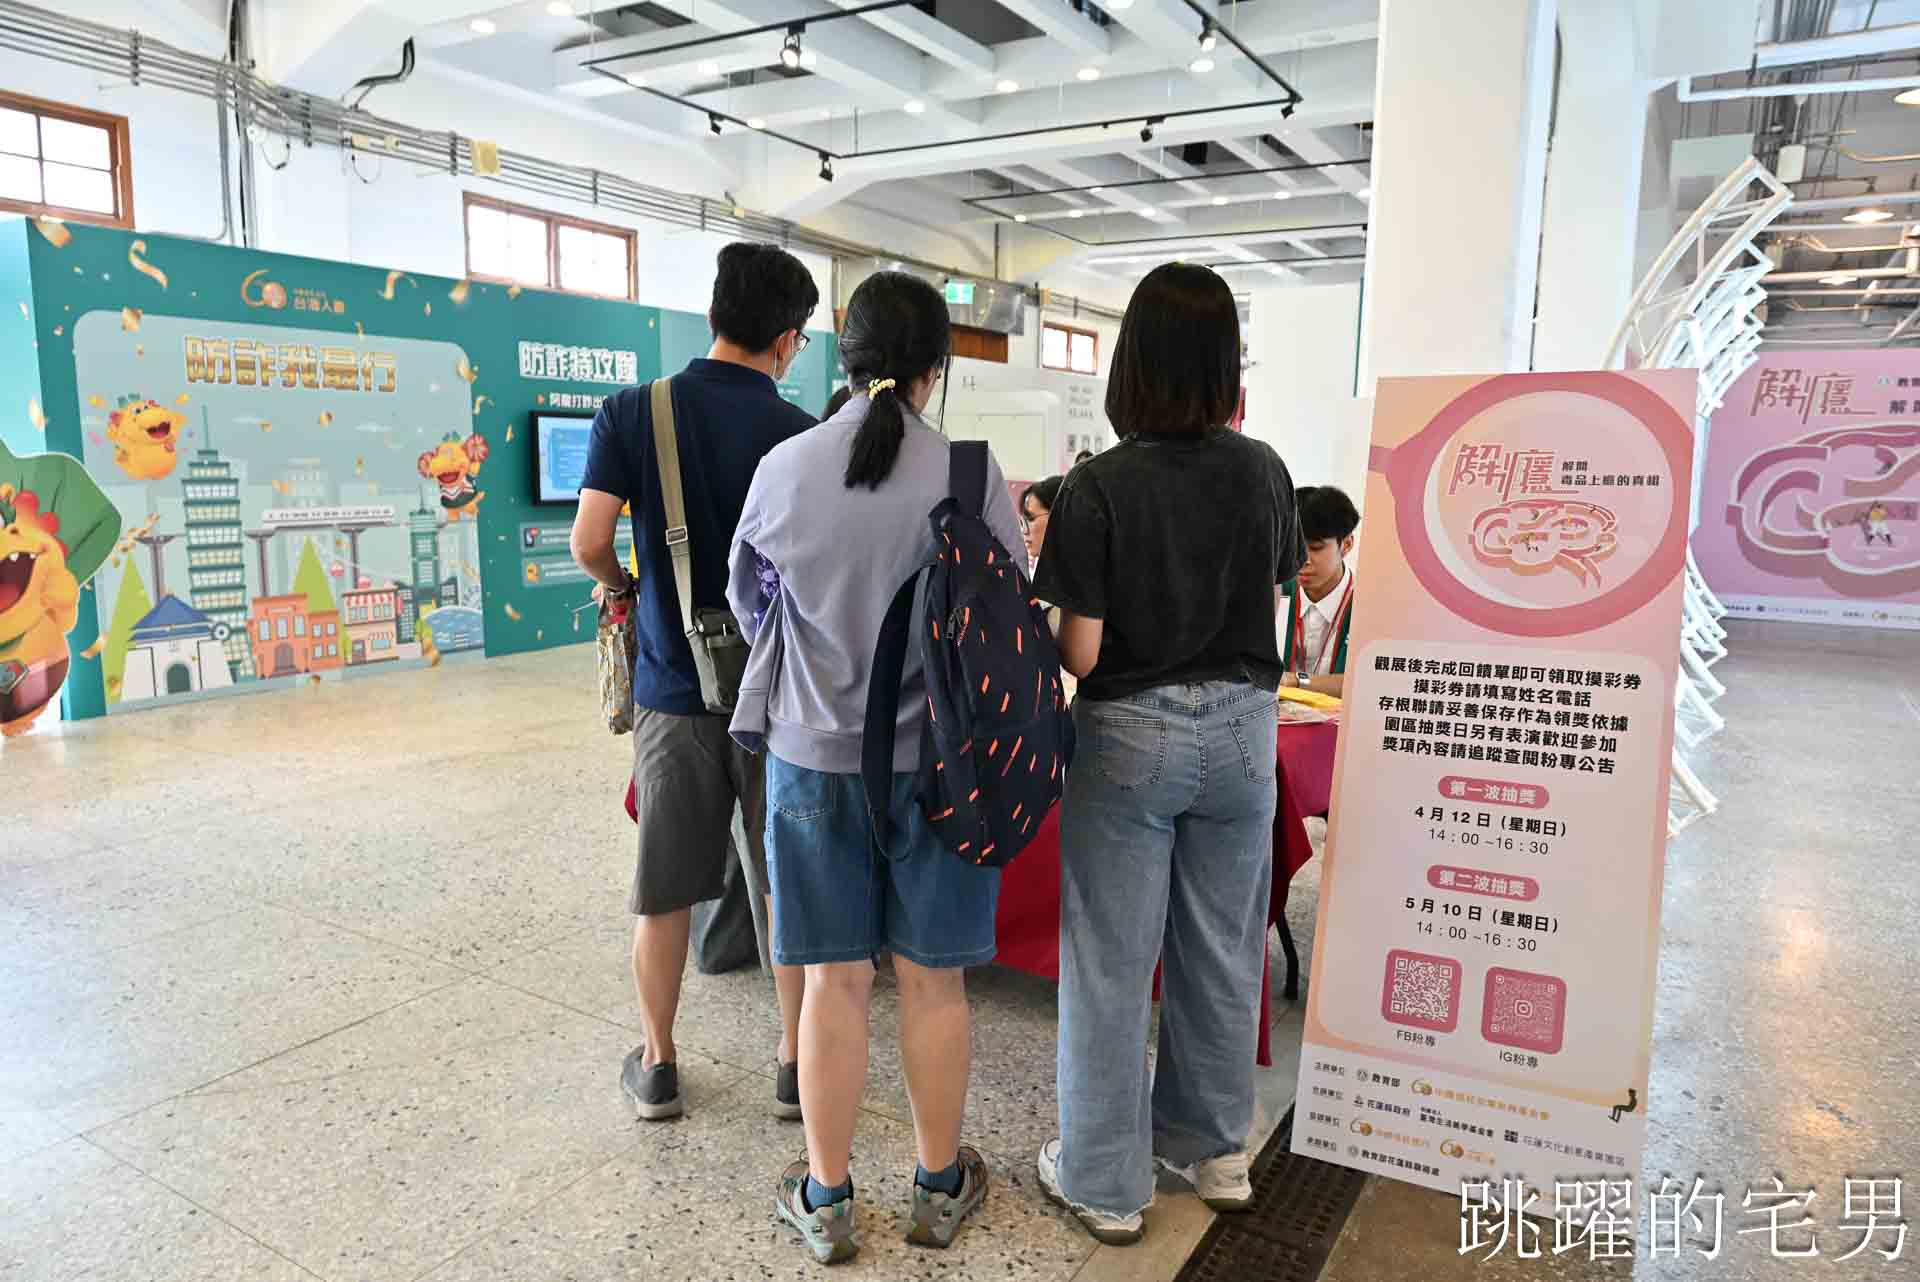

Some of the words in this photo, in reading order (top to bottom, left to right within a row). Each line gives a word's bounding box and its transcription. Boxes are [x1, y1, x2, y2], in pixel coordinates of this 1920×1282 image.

[185, 336, 397, 393] 防詐我最行
[518, 340, 638, 385] 防詐特攻隊
[1375, 656, 1641, 690] 觀展後完成回饋單即可領取摸彩券
[1413, 678, 1591, 708] 摸彩券請填寫姓名電話
[1378, 695, 1629, 732] 存根聯請妥善保存作為領獎依據
[1384, 716, 1617, 753] 園區抽獎日另有表演歡迎參加
[1382, 736, 1615, 774] 獎項內容請追蹤查閱粉專公告
[1449, 780, 1537, 804] 第一波抽獎
[1439, 870, 1527, 897] 第二波抽獎
[1397, 1030, 1435, 1047] FB粉專
[1499, 1051, 1539, 1068] IG粉專
